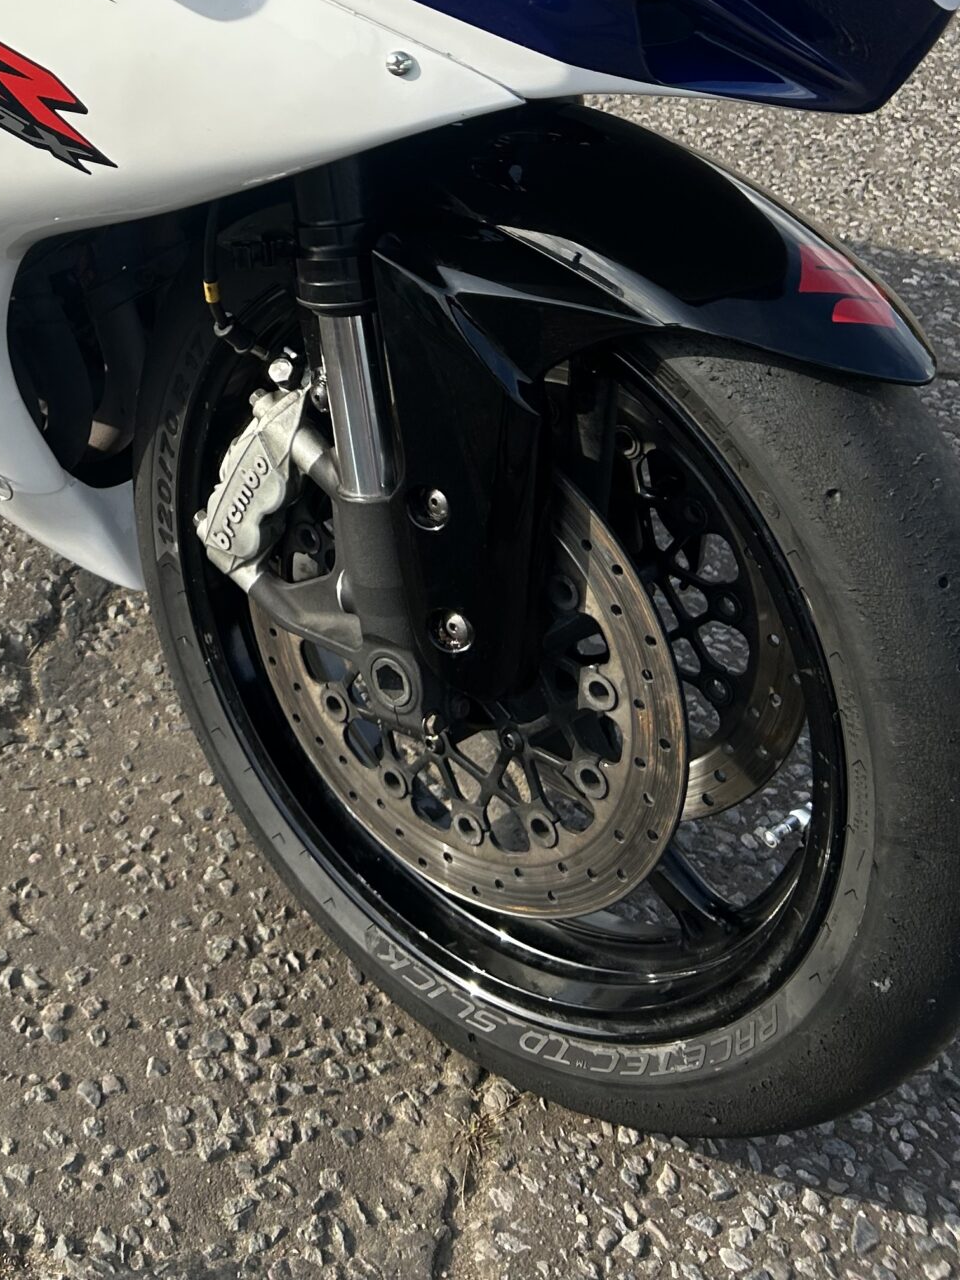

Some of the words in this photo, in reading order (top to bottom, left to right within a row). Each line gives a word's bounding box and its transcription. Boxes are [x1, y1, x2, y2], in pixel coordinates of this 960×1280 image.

[654, 361, 750, 468] ELER
[158, 410, 179, 546] 120/70
[212, 455, 269, 551] brembo
[377, 947, 508, 1034] SLICK
[518, 1029, 571, 1065] TD
